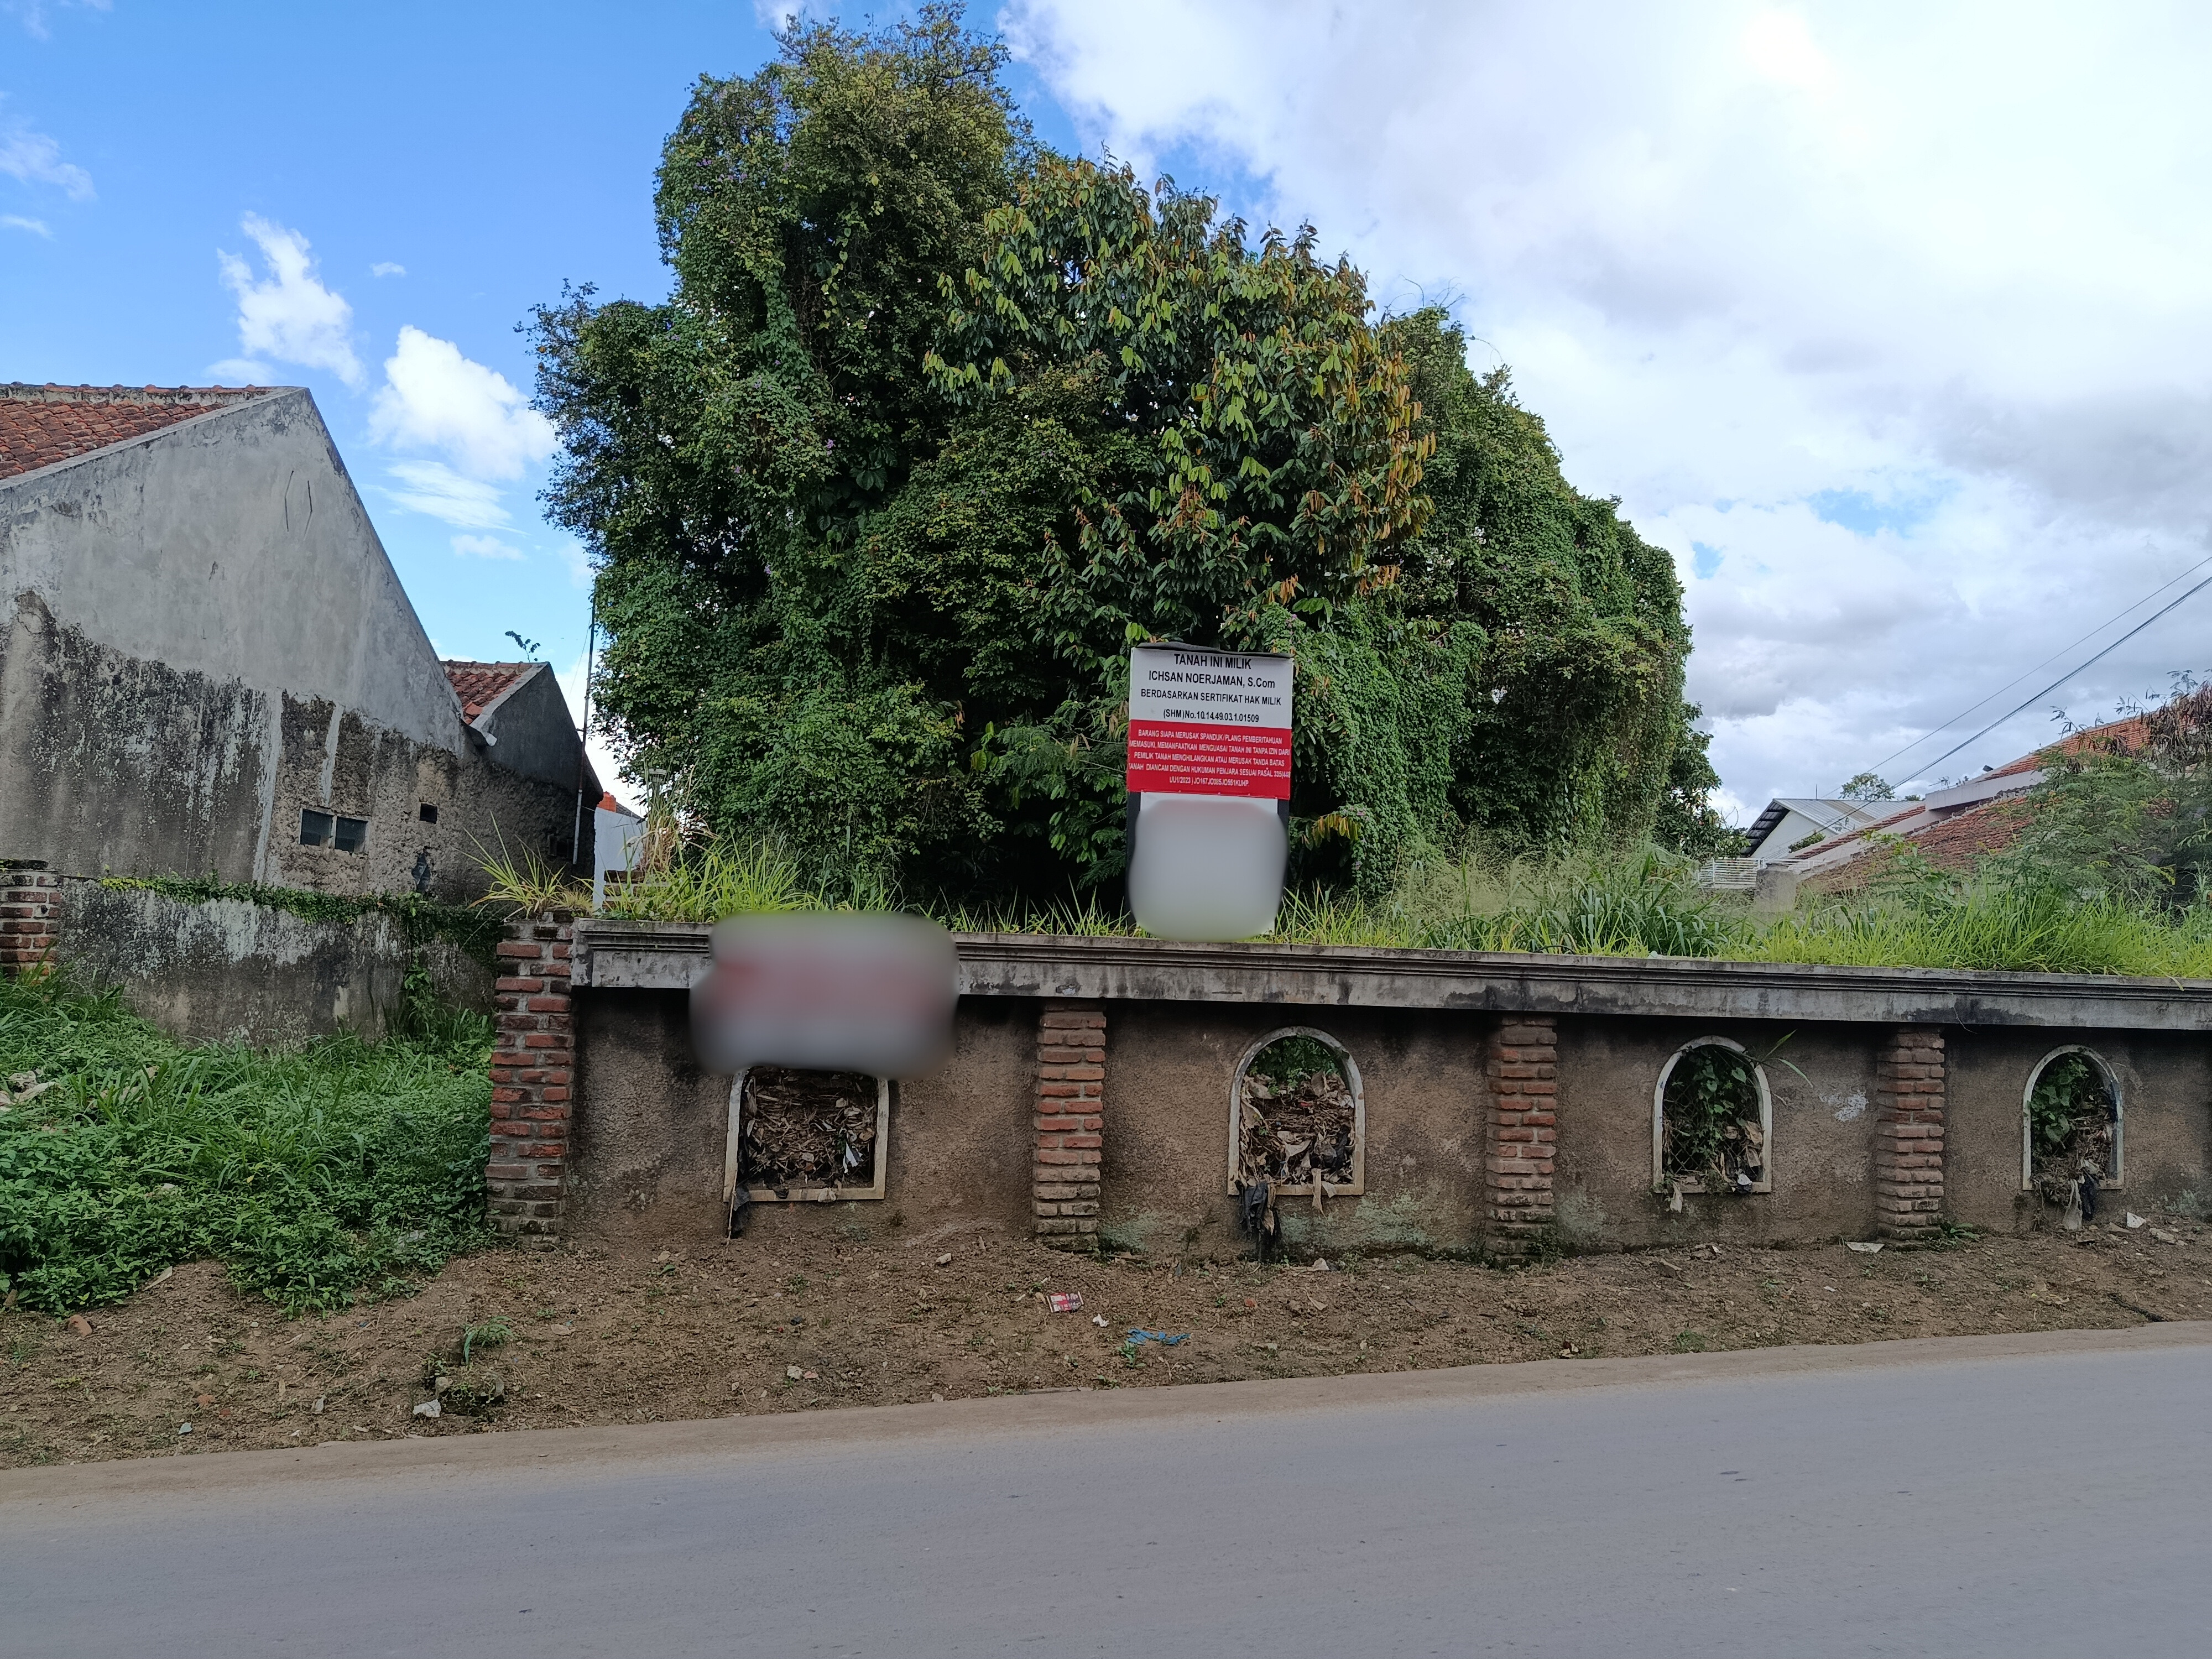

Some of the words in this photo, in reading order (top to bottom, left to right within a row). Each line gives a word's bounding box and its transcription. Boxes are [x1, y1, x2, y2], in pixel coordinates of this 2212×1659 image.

[1174, 653, 1207, 667] TANAH
[1210, 656, 1223, 668] INI
[1225, 657, 1251, 670] MILIK
[1149, 670, 1183, 682] ICHSAN
[1186, 672, 1245, 688] NOERJAMAN,
[1248, 677, 1275, 688] S.Com
[1141, 688, 1198, 700] BERDASARKAN
[1200, 692, 1243, 703] SERTIFIKAT
[1244, 695, 1260, 705] HAK
[1261, 696, 1281, 706] MILIK
[1138, 729, 1160, 737] BARANG
[1242, 735, 1282, 744] PEMBERITAHUAN
[1157, 742, 1197, 750] MEMANFAATKAN
[1199, 744, 1228, 752] MENGUASAI
[1172, 754, 1214, 763] MENGHILANGKAN
[1228, 757, 1252, 765] MERUSAK
[1170, 764, 1190, 773] DENGAN
[1239, 768, 1257, 776] SESUAI
